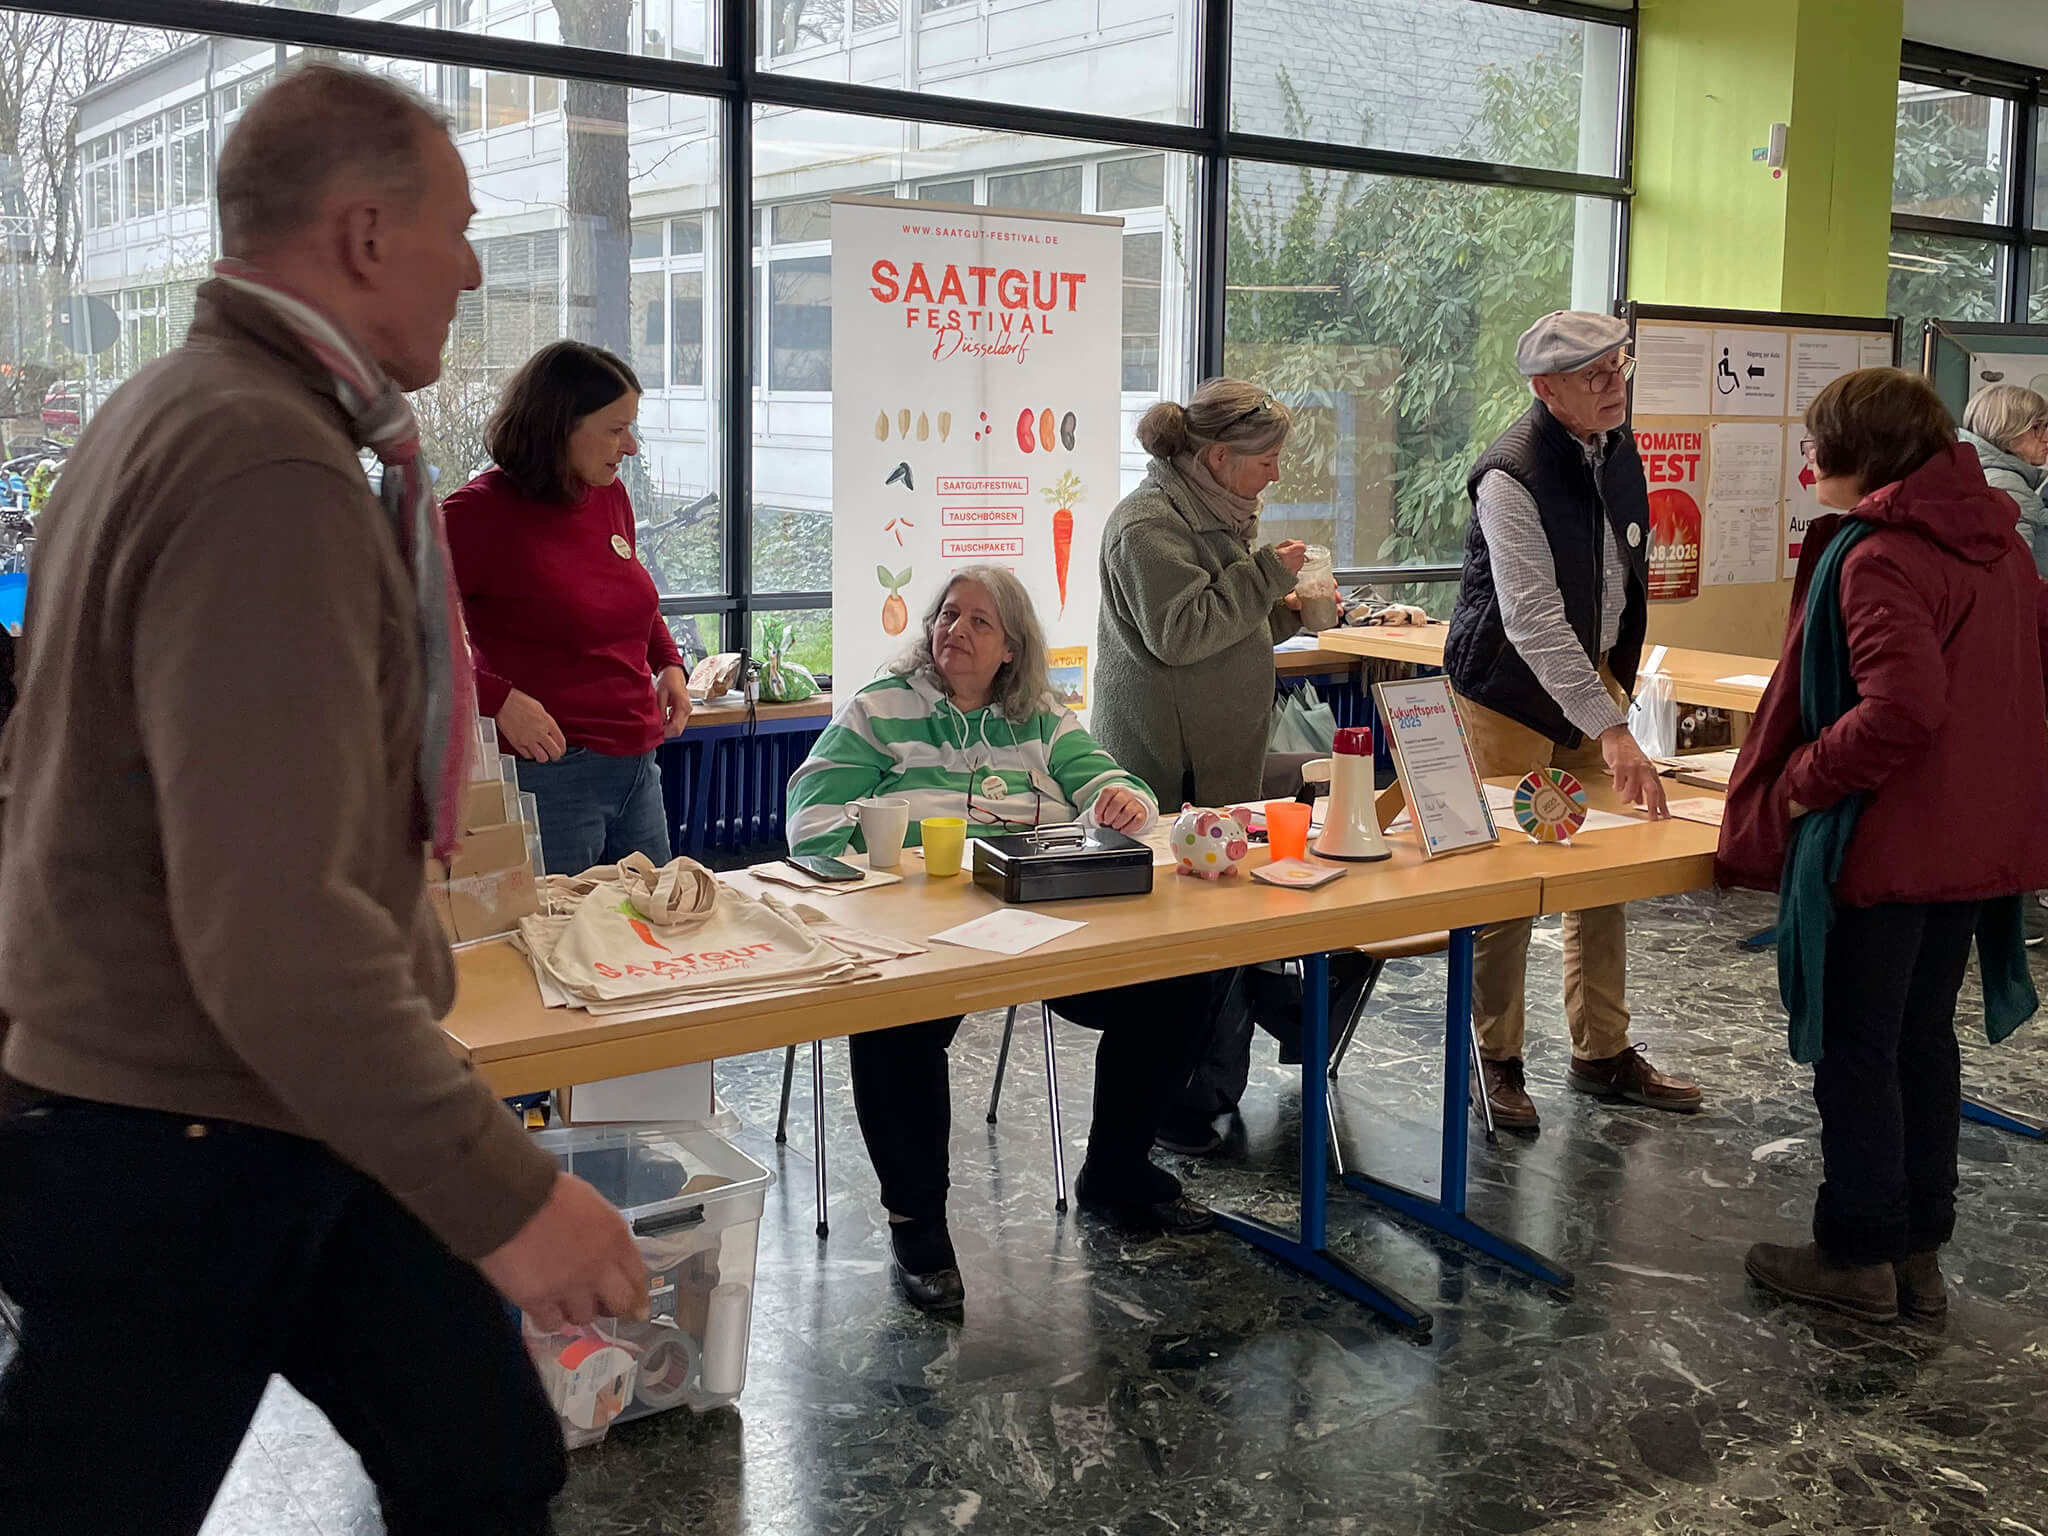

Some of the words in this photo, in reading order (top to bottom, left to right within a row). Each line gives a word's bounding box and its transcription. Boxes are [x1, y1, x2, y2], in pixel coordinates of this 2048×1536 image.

[902, 225, 1059, 245] WWW.SAATGUT-FESTIVAL.DE
[869, 259, 1087, 312] SAATGUT
[906, 308, 1054, 334] FESTIVAL
[932, 325, 1031, 364] Düsseldorf
[1633, 432, 1701, 450] TOMATEN
[943, 481, 1023, 490] SAATGUT-FESTIVAL
[949, 511, 1017, 521] TAUSCHBÖRSEN
[950, 542, 1016, 552] TAUSCHPAKETE
[1388, 704, 1446, 720] Zukunftspreis
[1399, 716, 1422, 729] 2025
[594, 943, 774, 979] SAATGUT
